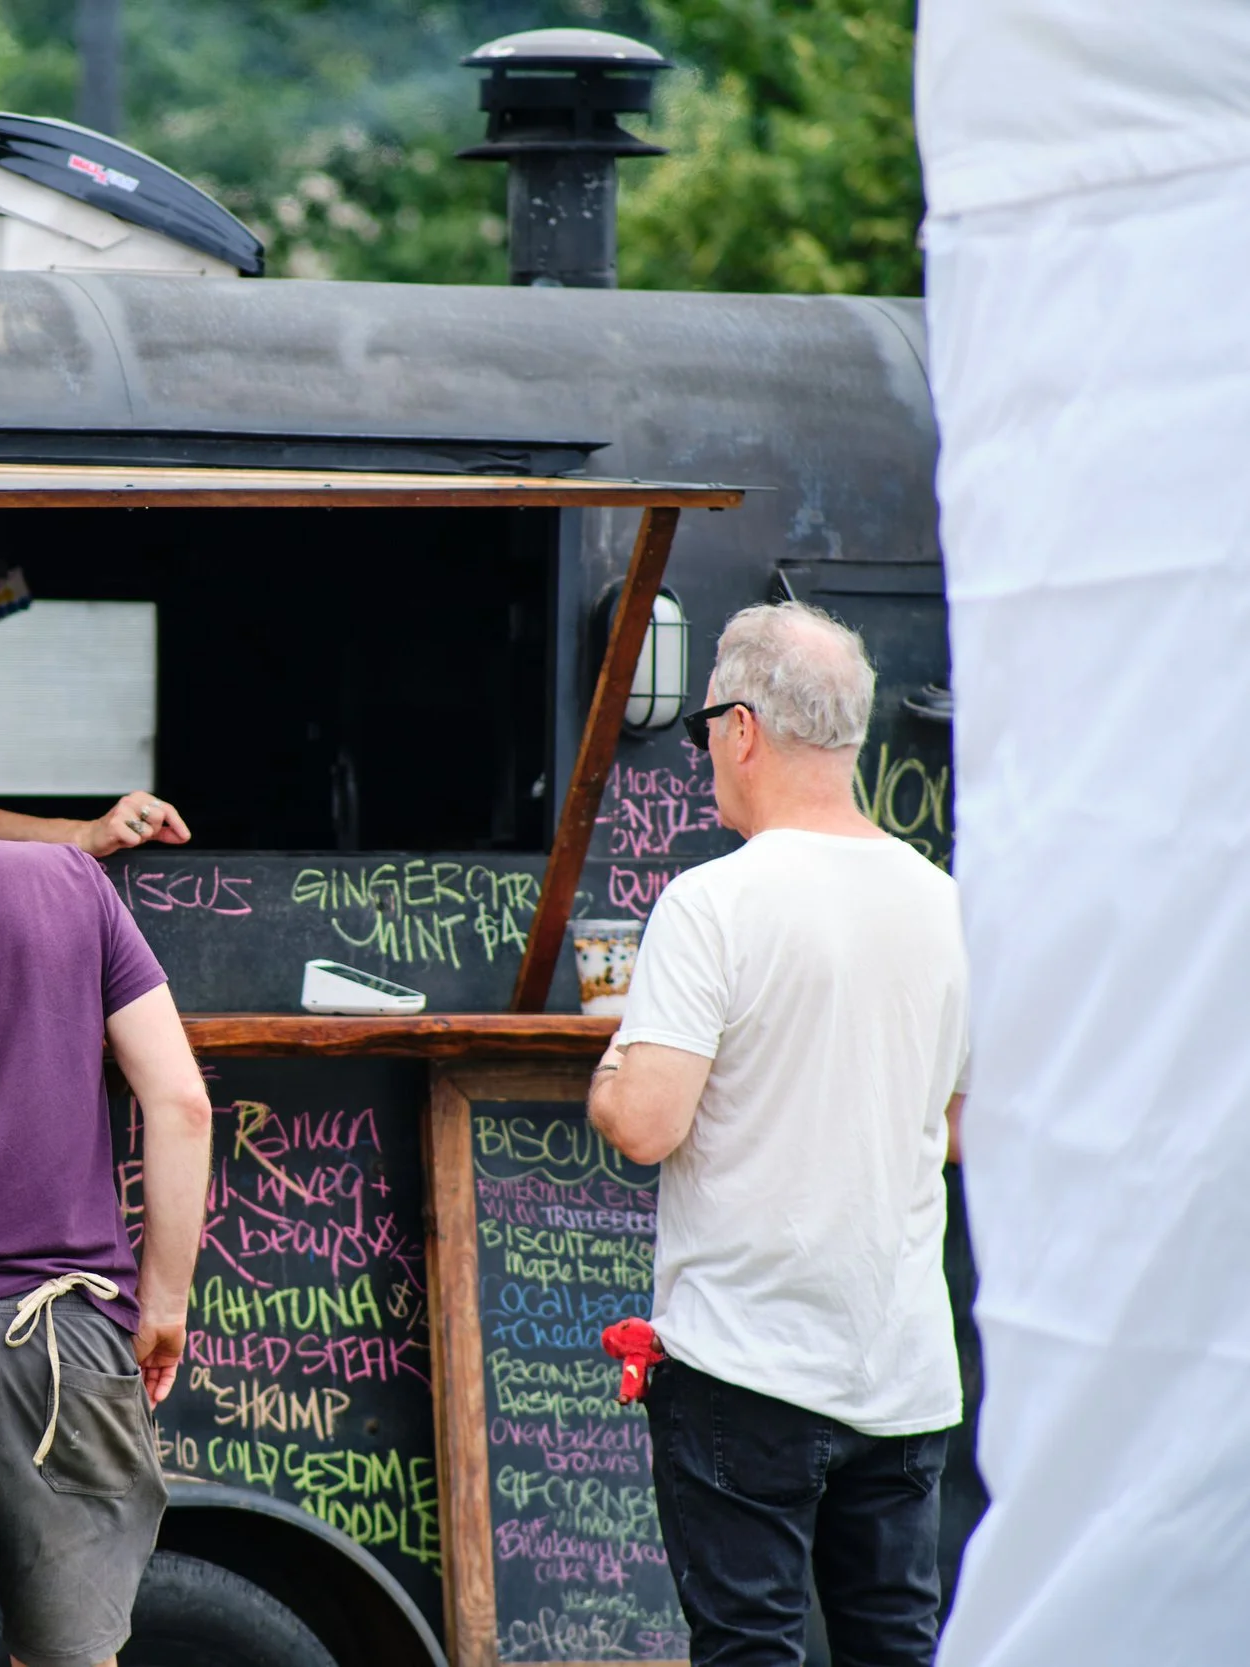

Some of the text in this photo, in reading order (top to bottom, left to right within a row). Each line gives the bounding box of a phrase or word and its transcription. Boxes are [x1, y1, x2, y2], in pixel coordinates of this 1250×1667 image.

[291, 860, 466, 920] GINGER
[332, 908, 466, 970] MINT
[478, 1219, 594, 1259] BISCUIT
[202, 1275, 267, 1335] AHI
[265, 1273, 382, 1335] TUNA
[179, 1330, 433, 1393] RILLED STEAK
[213, 1377, 351, 1442] SHRIMP
